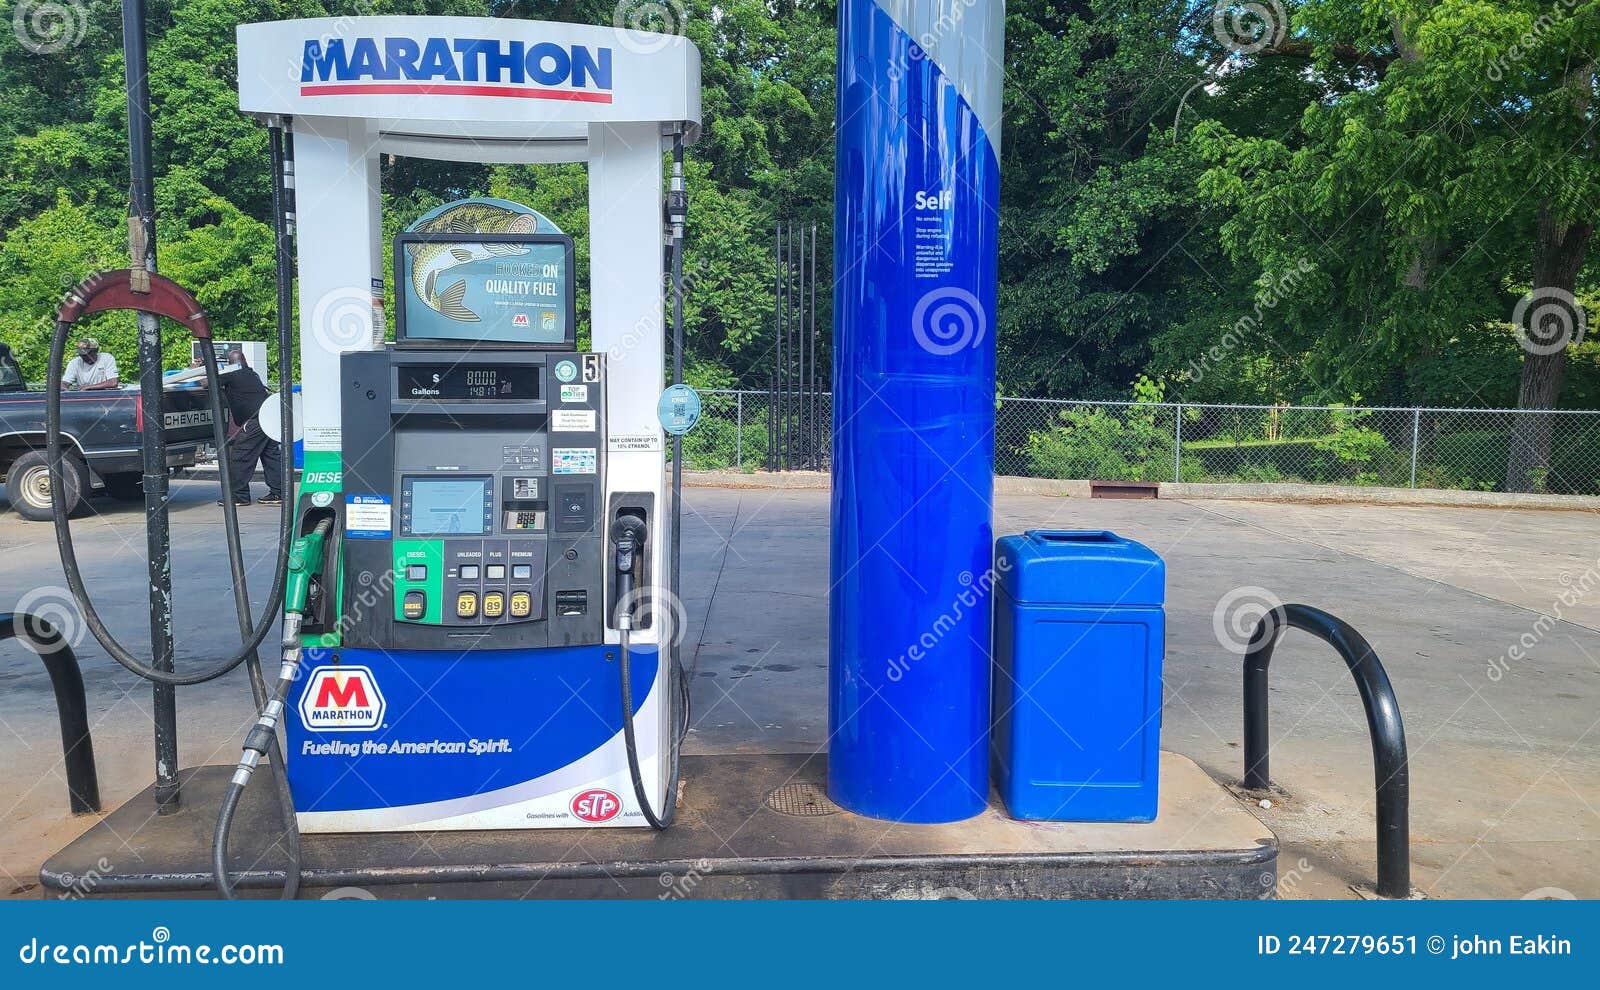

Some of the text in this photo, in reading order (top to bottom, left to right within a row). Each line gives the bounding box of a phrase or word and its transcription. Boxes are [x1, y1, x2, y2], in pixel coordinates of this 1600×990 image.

[301, 38, 612, 89] MARATHON
[915, 190, 952, 210] Self
[542, 264, 559, 278] ON
[485, 279, 558, 296] QUALITY FUEL
[585, 355, 597, 381] 5
[411, 388, 440, 396] Gallons
[306, 472, 342, 483] DIESE
[460, 602, 474, 610] 87
[487, 602, 501, 610] 89
[513, 602, 527, 610] 93
[312, 710, 373, 720] MARATHON
[302, 738, 513, 757] Fueling the American Spirit.
[577, 793, 616, 818] STP
